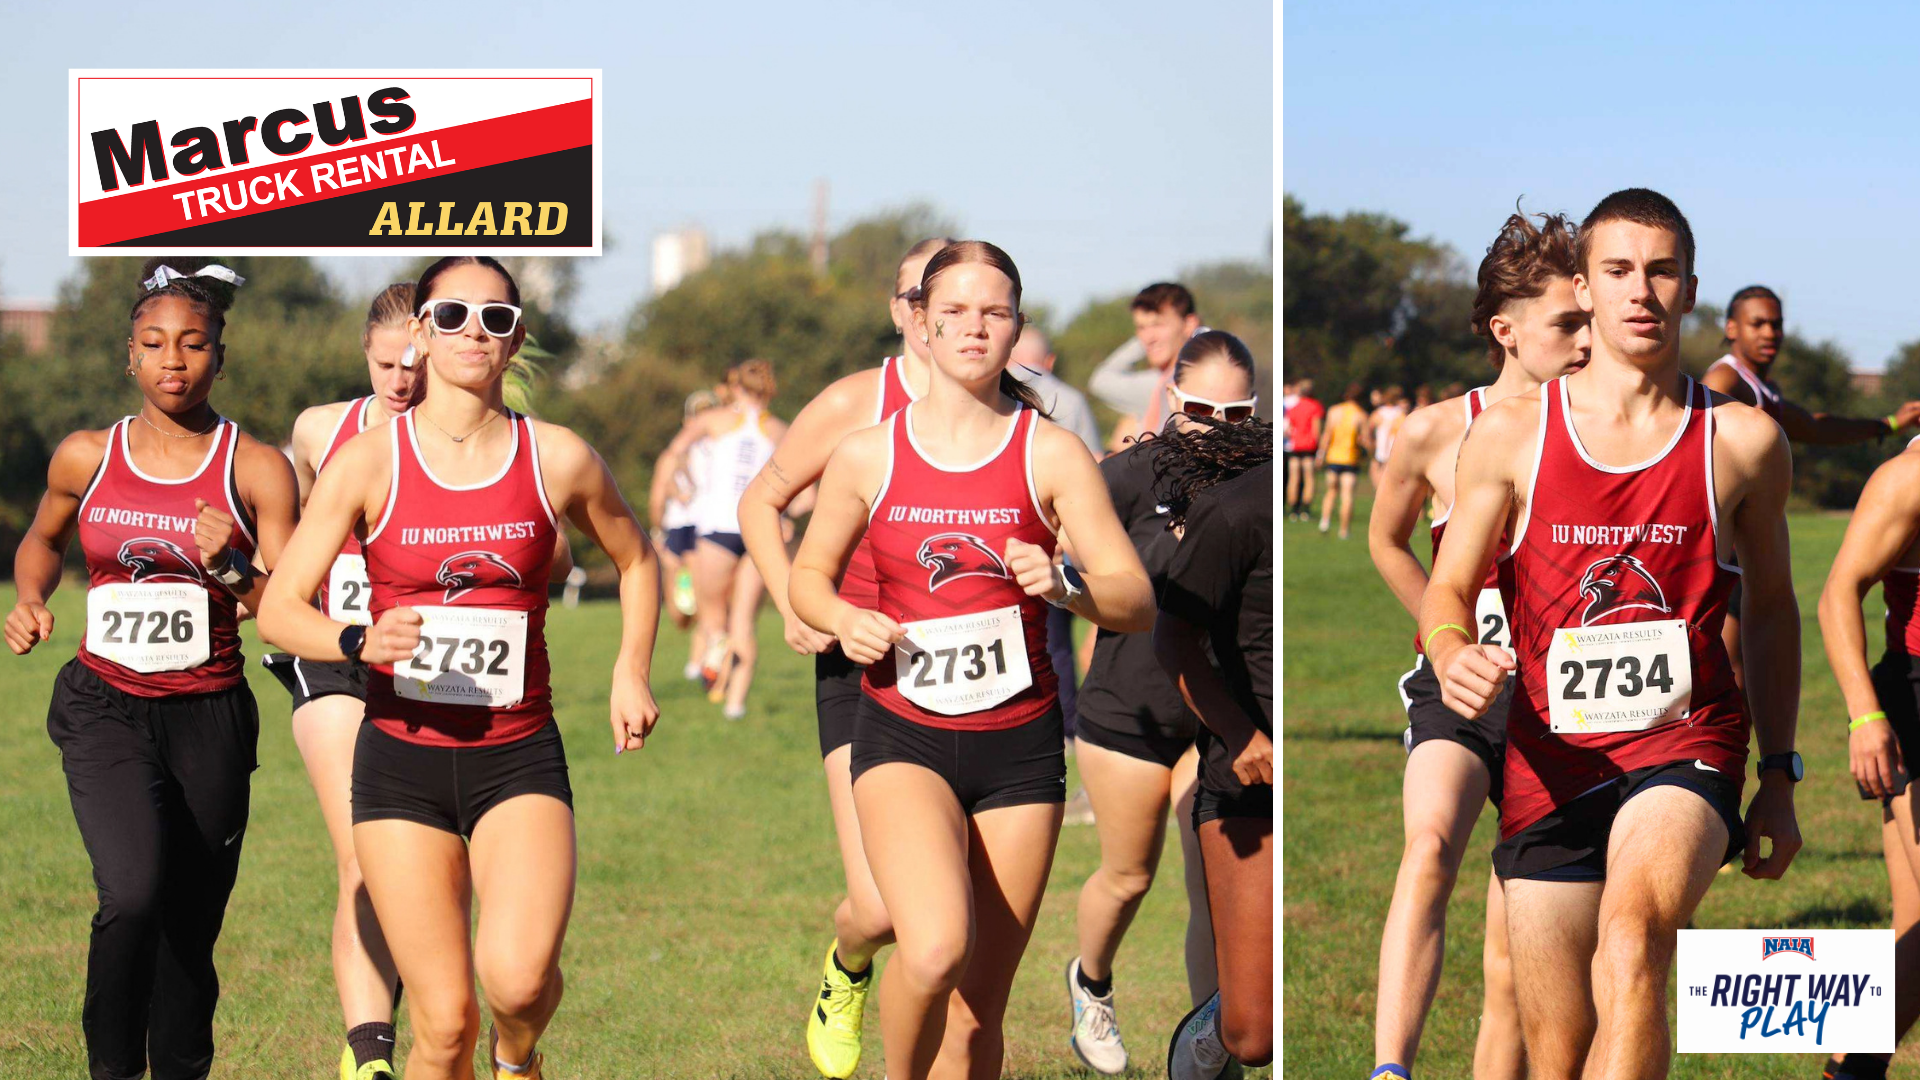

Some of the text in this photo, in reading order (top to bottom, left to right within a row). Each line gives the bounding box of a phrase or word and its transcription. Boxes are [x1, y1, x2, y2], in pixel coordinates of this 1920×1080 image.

[88, 507, 106, 523] IU
[887, 506, 1020, 525] IU NORTHWEST
[401, 521, 536, 545] IU NORTHWEST
[1552, 523, 1687, 546] IU NORTHWEST
[102, 609, 194, 644] 2726
[1576, 632, 1620, 643] WAYZATA
[1622, 628, 1663, 640] RESULTS
[410, 635, 510, 676] 2732
[910, 638, 1007, 688] 2731
[1560, 653, 1674, 700] 2734
[427, 683, 467, 694] WAYZATA
[1584, 711, 1627, 721] WAYZATA
[1629, 706, 1669, 718] RESULTS
